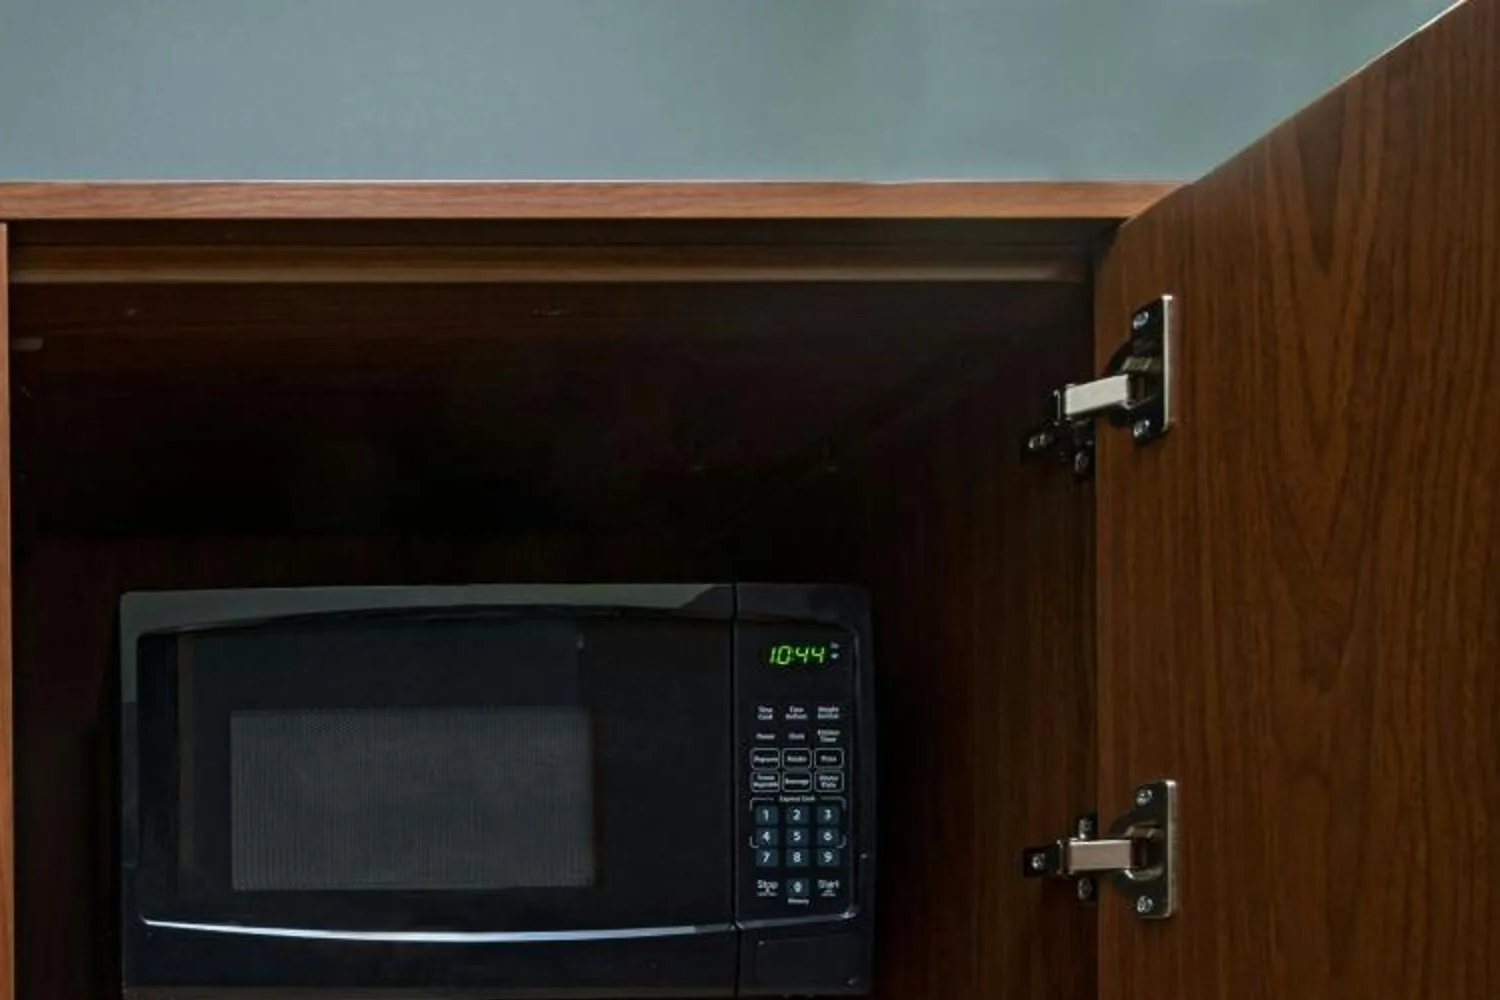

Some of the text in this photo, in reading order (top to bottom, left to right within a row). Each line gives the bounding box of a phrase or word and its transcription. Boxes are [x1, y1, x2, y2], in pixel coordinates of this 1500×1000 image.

[762, 809, 770, 821] 1
[792, 809, 801, 821] 2
[823, 809, 832, 821] 3
[762, 831, 771, 842] 4
[792, 831, 801, 842] 5
[823, 831, 833, 842] 6
[762, 851, 771, 863] 7
[792, 851, 801, 863] 8
[823, 851, 833, 863] 9
[756, 879, 780, 890] Stop
[793, 881, 802, 893] 0
